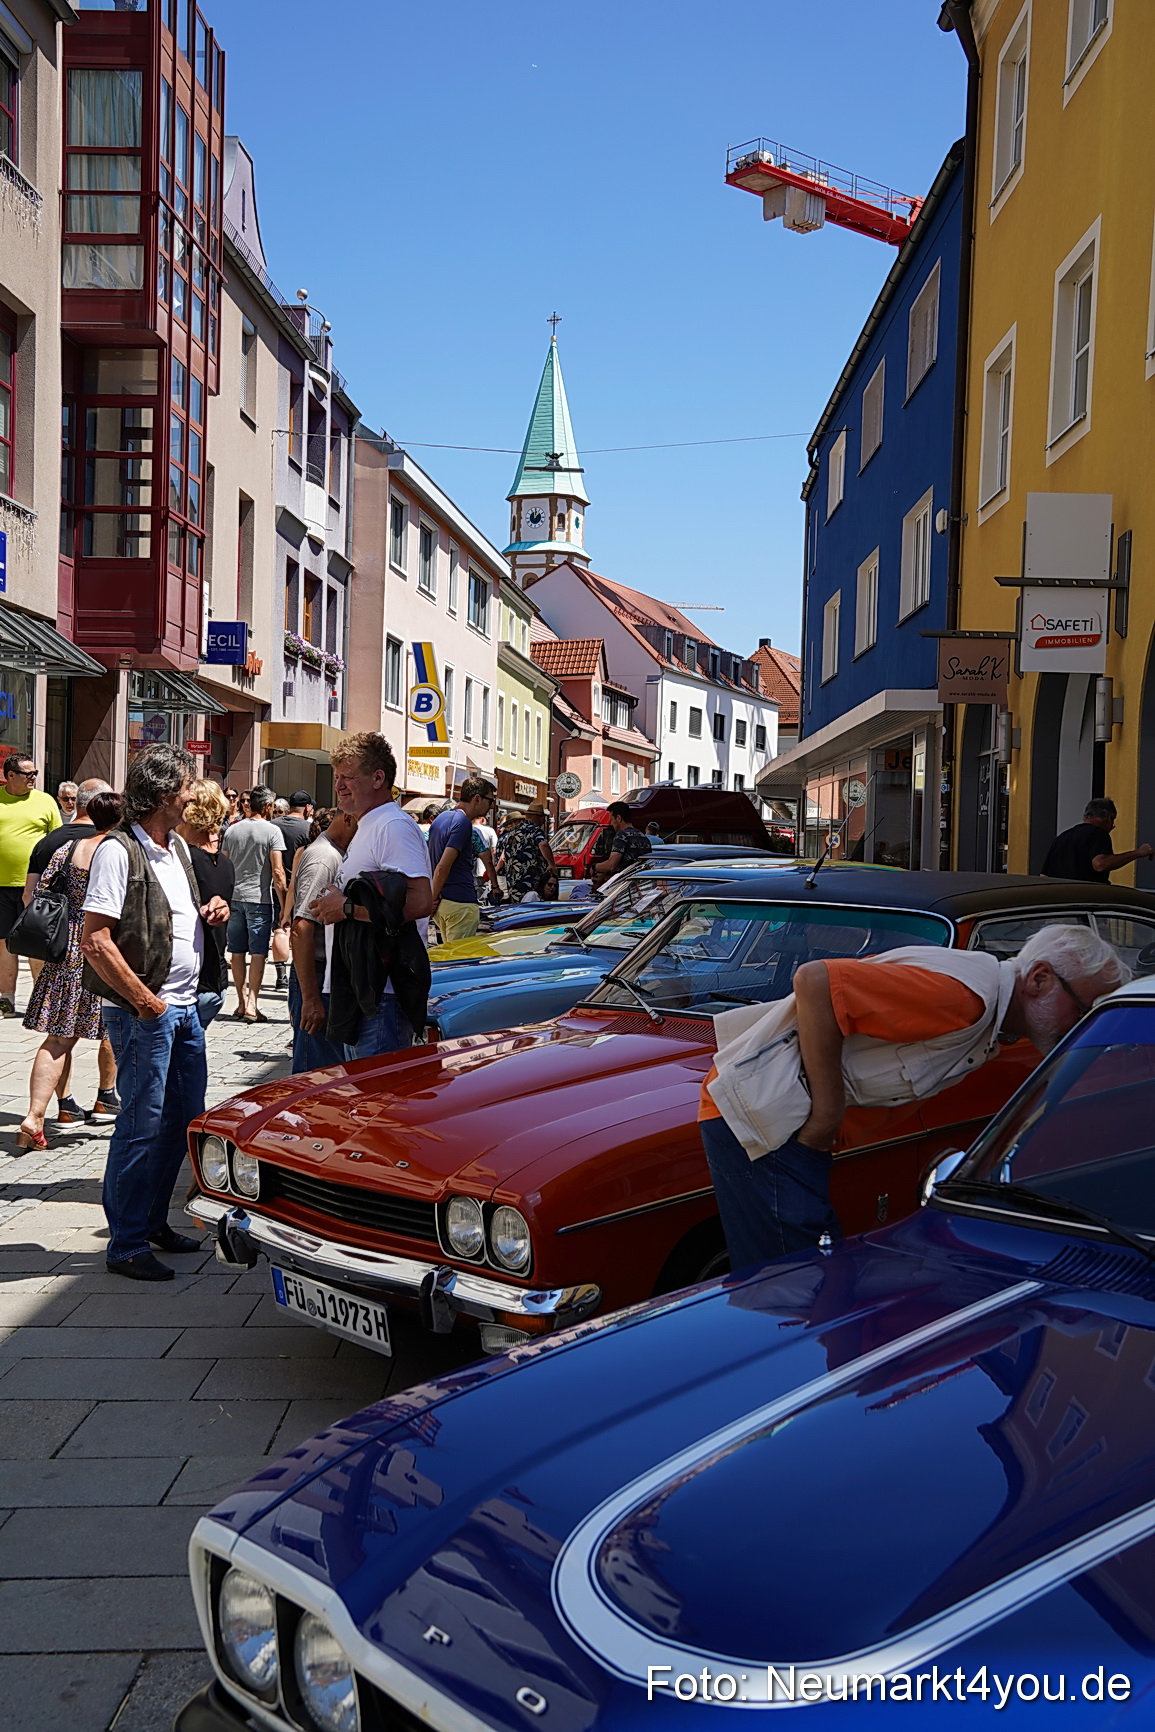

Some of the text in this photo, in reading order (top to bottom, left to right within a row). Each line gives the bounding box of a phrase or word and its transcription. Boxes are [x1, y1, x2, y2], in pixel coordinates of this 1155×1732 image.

[208, 634, 240, 647] ECIL
[943, 656, 1005, 680] Sarah K
[414, 693, 433, 712] B
[284, 1276, 306, 1311] FÜ
